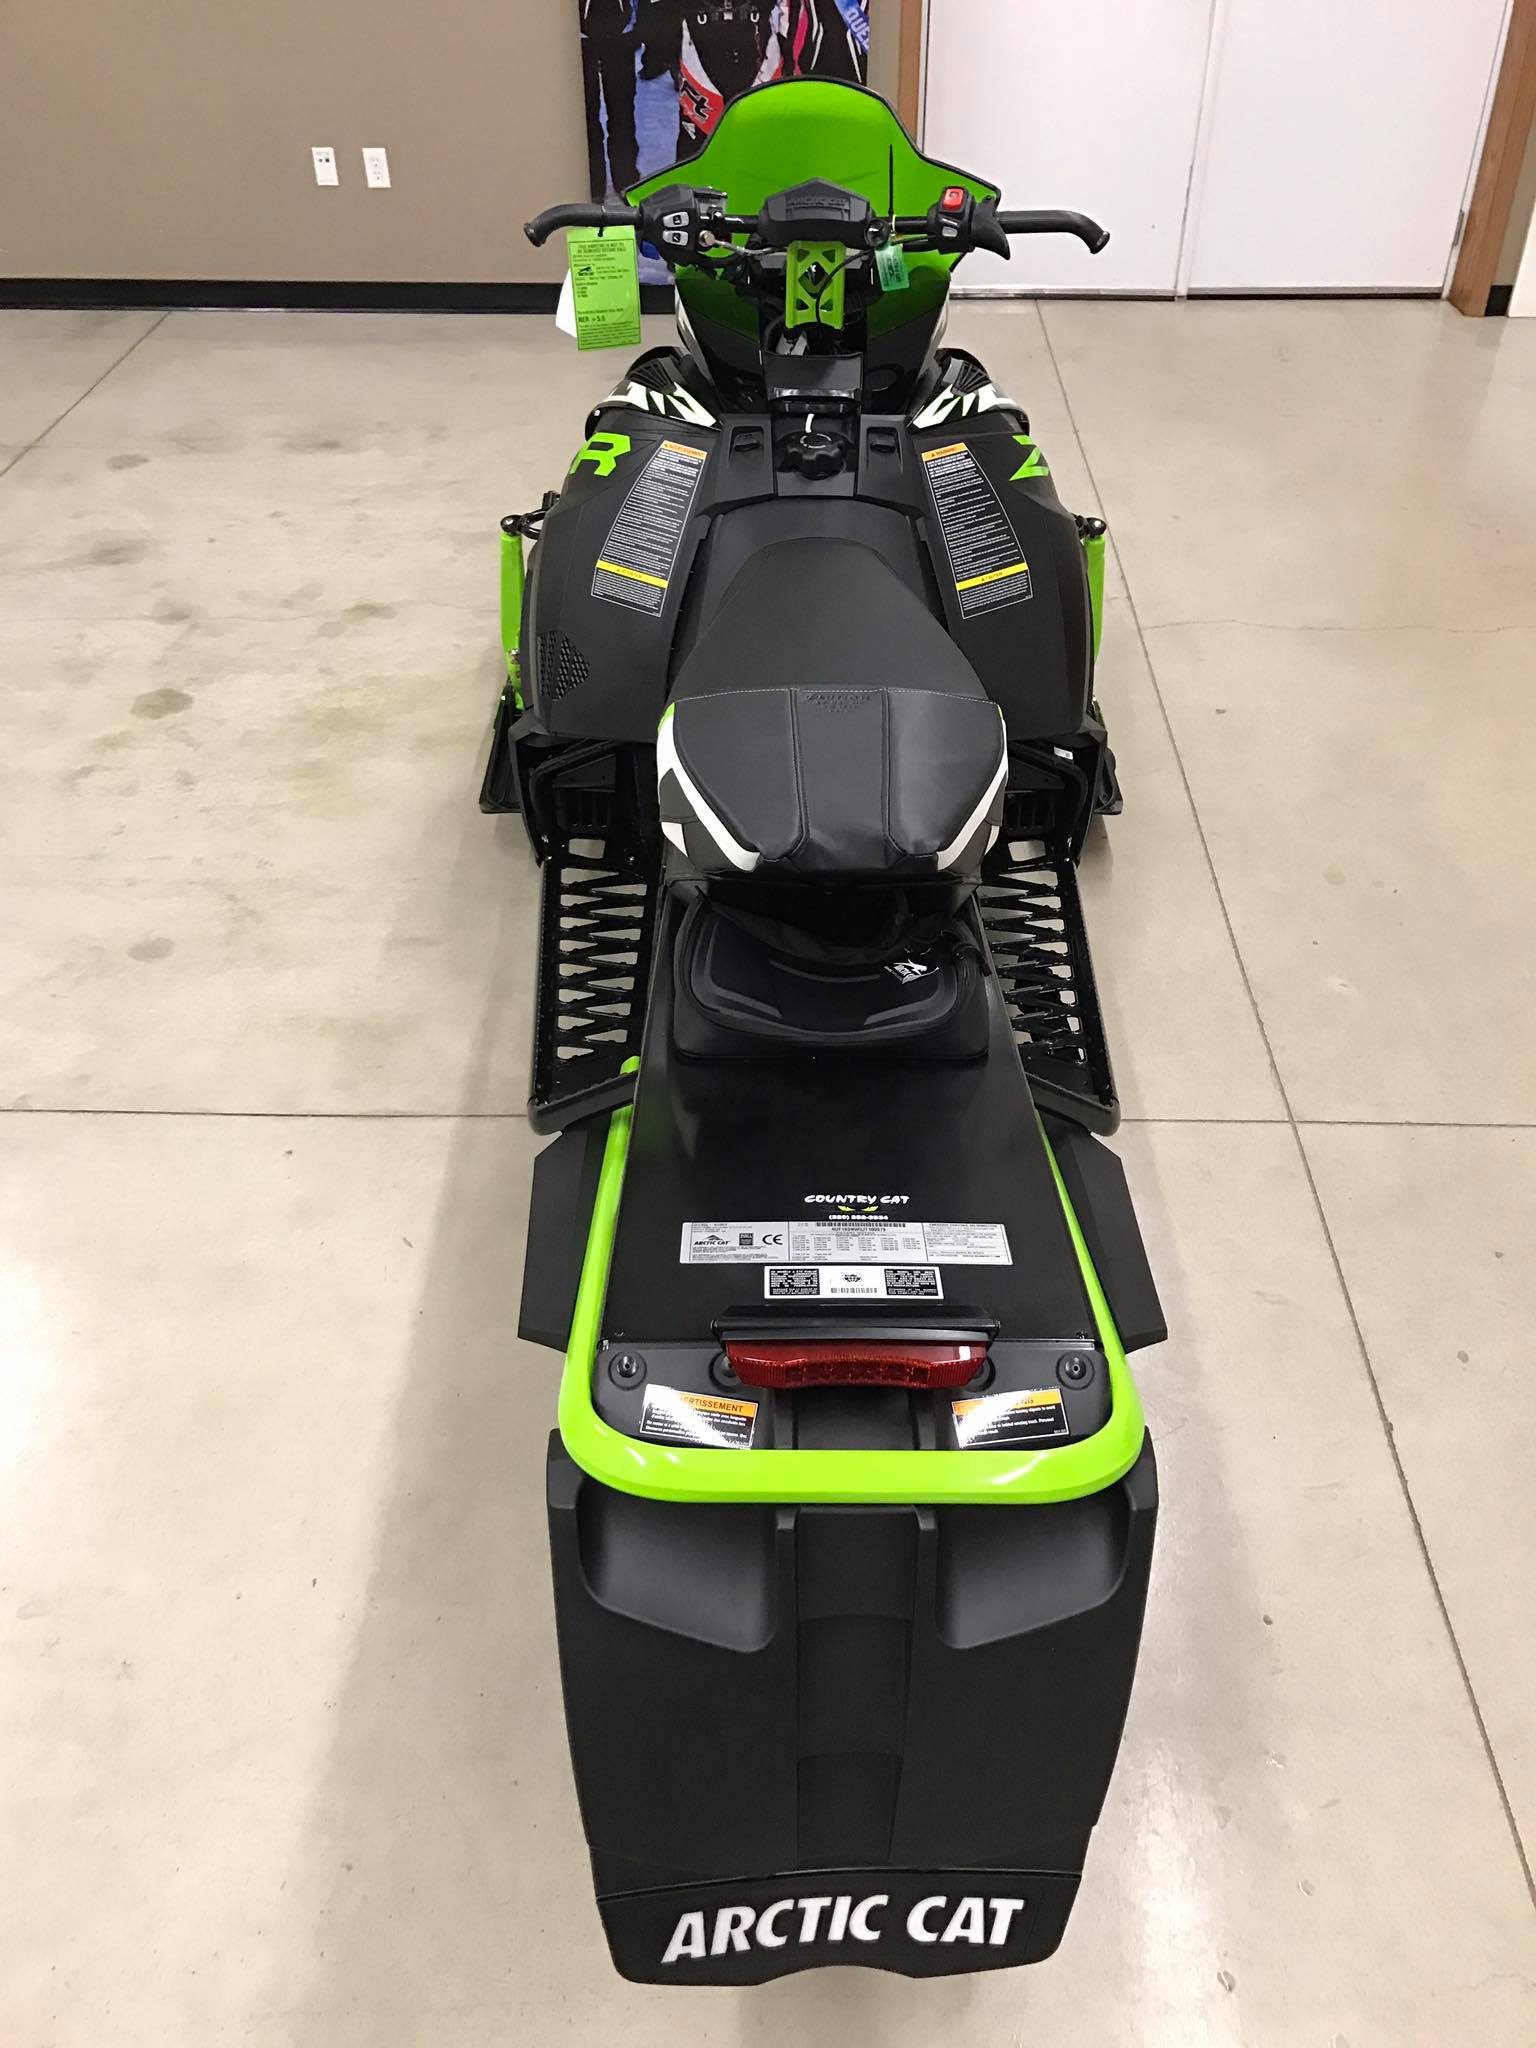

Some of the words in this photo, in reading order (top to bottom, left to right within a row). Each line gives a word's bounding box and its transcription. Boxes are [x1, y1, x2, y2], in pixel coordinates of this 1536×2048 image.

[569, 432, 631, 476] R
[804, 1194, 878, 1205] COUNTRY
[880, 1195, 910, 1204] CAT
[660, 1894, 889, 1964] ARCTIC
[906, 1895, 1025, 1945] CAT
